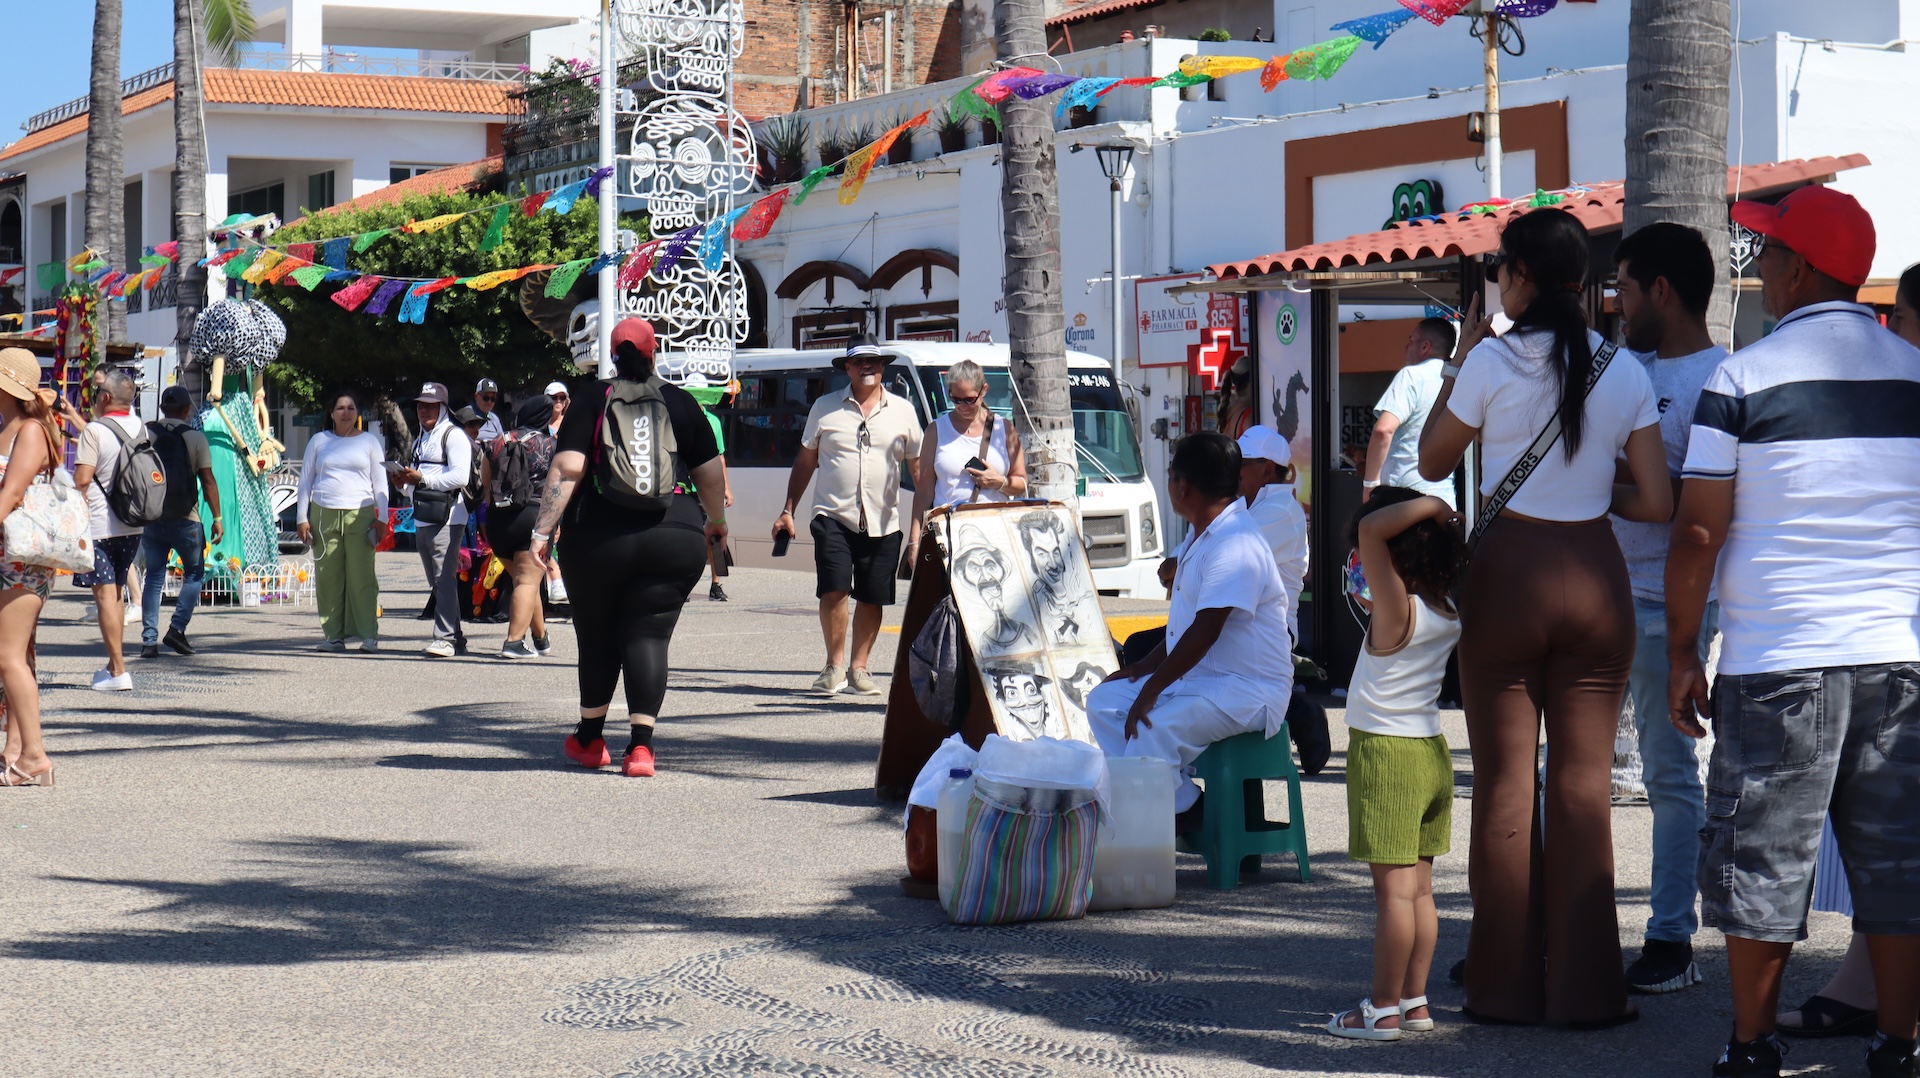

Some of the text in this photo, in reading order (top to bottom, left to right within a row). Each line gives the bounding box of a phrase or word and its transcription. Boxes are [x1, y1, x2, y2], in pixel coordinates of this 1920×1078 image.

[1151, 307, 1197, 322] FARMACIA
[1065, 326, 1095, 345] Corona
[1151, 321, 1184, 331] PHARMACY
[1342, 404, 1373, 425] FIES
[1341, 424, 1372, 445] SIES
[630, 415, 652, 495] adidas
[1475, 453, 1539, 536] MICHAEL KORS
